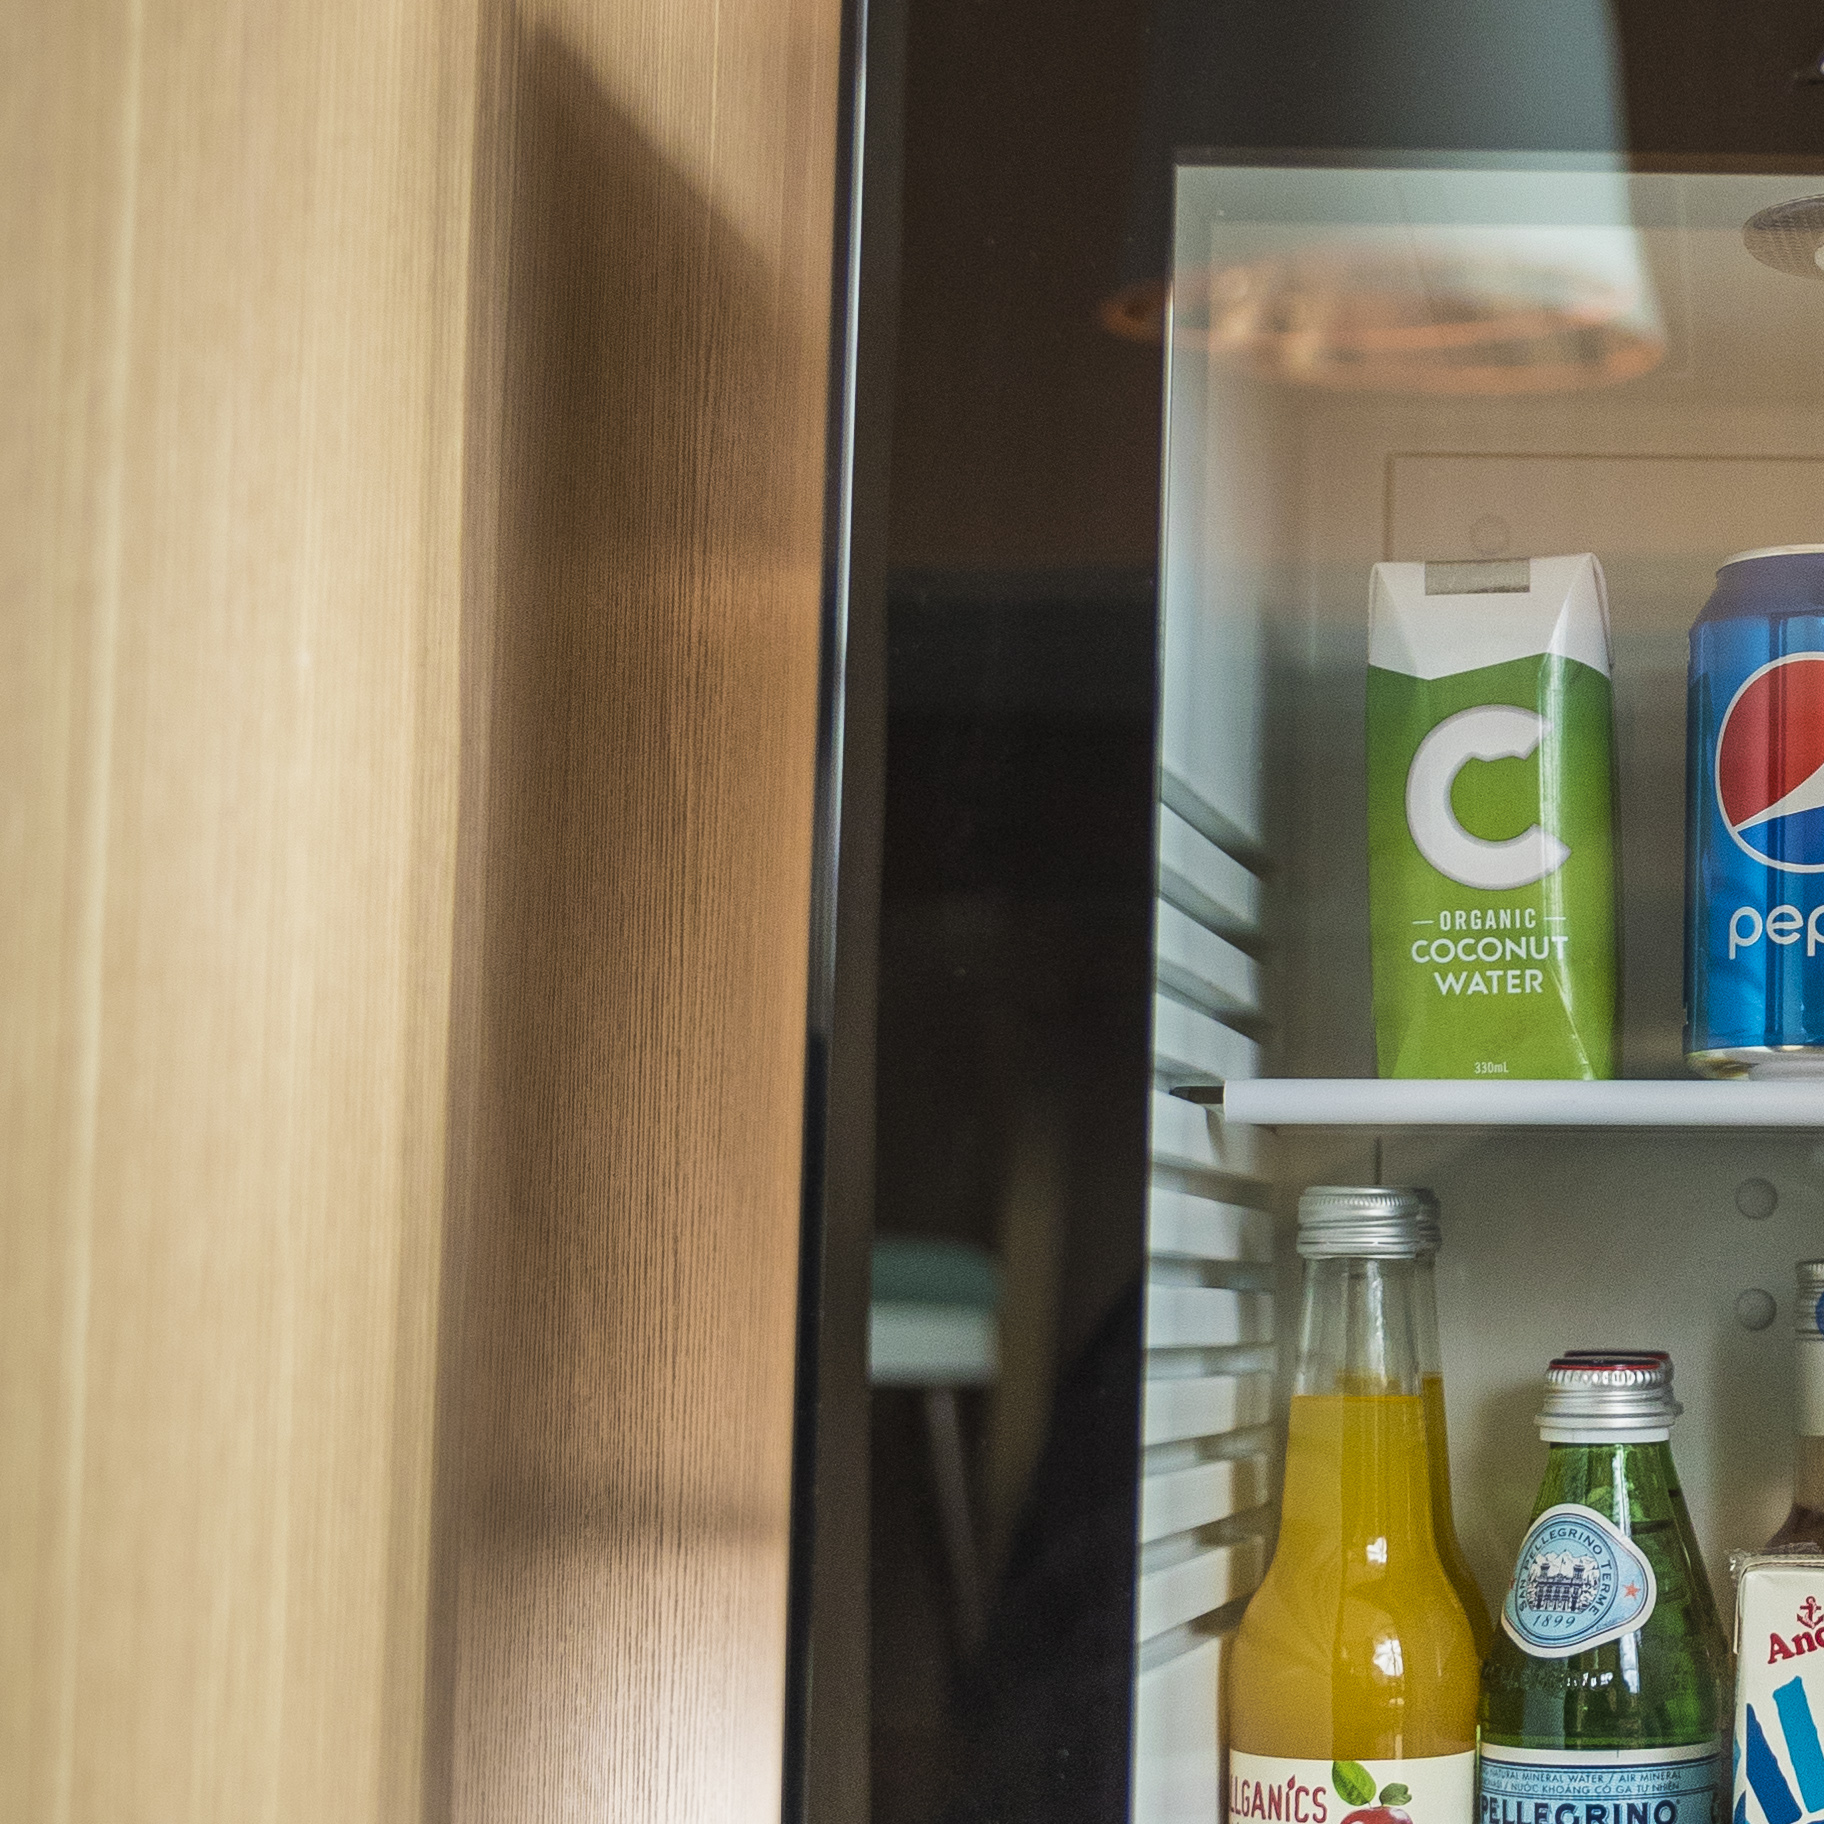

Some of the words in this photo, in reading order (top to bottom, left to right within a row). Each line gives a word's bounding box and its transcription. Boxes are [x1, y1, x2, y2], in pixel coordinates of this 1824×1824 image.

[1405, 703, 1572, 891] C
[1439, 907, 1537, 932] ORGANIC
[1411, 935, 1569, 965] COCONUT
[1433, 969, 1544, 995] WATER
[1522, 1527, 1603, 1571] PELLEGRINO
[1519, 1579, 1528, 1612] SAN
[1588, 1559, 1612, 1616] TERME
[1532, 1614, 1576, 1629] 1899
[1522, 1772, 1564, 1782] MINERAL
[1567, 1774, 1604, 1784] WATER
[1618, 1773, 1637, 1783] AIR
[1615, 1784, 1632, 1794] GA
